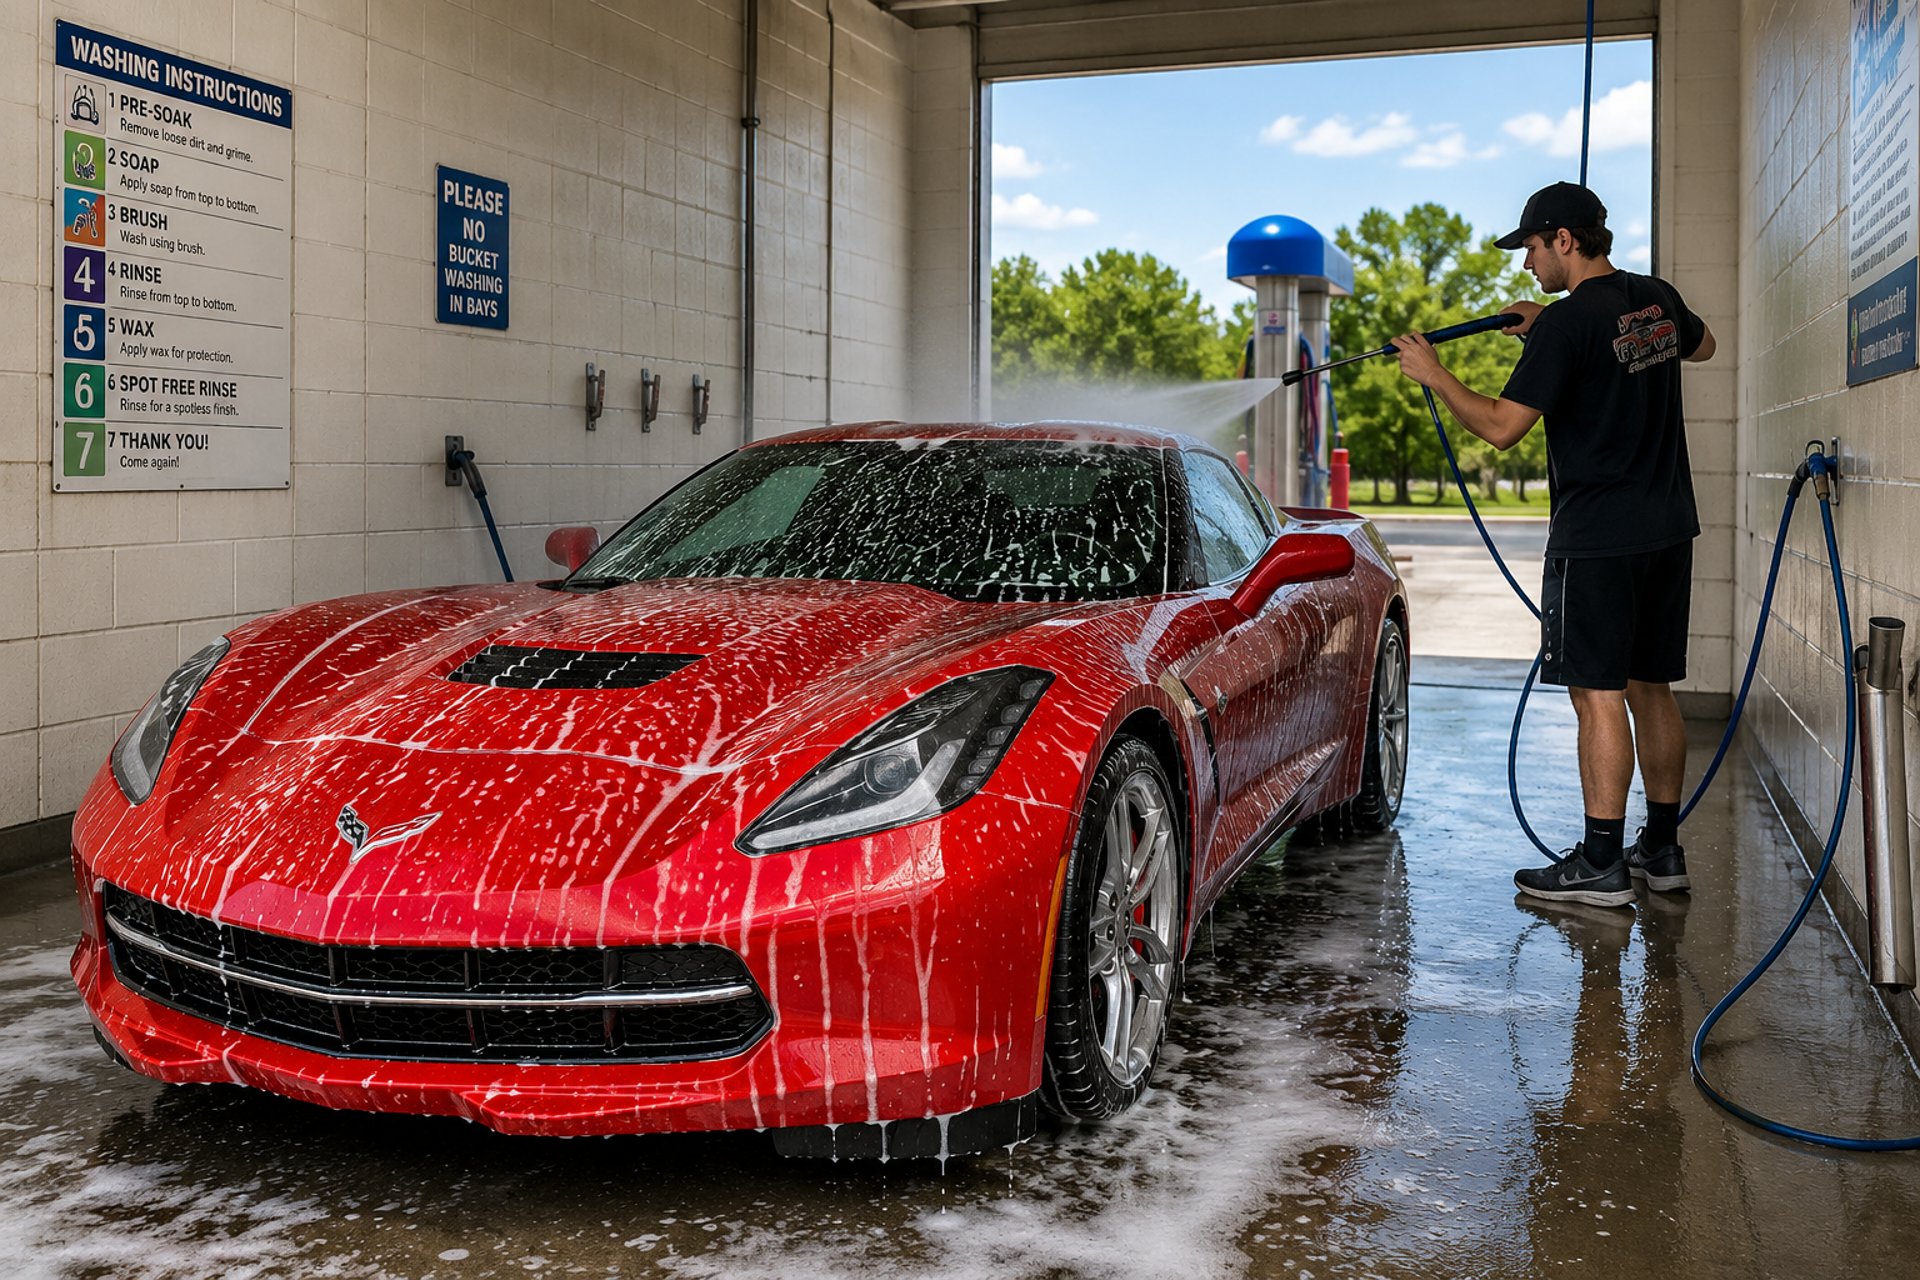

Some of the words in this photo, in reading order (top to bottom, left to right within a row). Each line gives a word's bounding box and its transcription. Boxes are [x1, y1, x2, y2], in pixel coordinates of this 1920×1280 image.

[71, 35, 159, 82] WASHING
[166, 64, 282, 118] INSTRUCTIONS
[108, 92, 115, 108] 1
[120, 94, 192, 129] PRE-SOAK
[120, 117, 159, 139] Remove
[162, 128, 187, 146] loose
[190, 136, 205, 151] dirt
[207, 143, 224, 155] and
[226, 148, 253, 163] grime.
[108, 147, 117, 165] 2
[120, 151, 159, 174] SOAP
[120, 174, 148, 192] Apply
[150, 183, 173, 198] soap
[175, 185, 196, 201] from
[198, 191, 214, 207] top
[215, 195, 225, 207] to
[444, 179, 503, 216] PLEASE
[108, 204, 116, 220] 3
[120, 207, 168, 231] BRUSH
[463, 217, 486, 243] NO
[120, 229, 147, 246] Wash
[150, 236, 175, 254] using
[177, 242, 206, 256] brush.
[449, 243, 499, 270] BUCKET
[74, 256, 95, 293] 4
[108, 261, 116, 276] 4
[120, 263, 161, 284] RINSE
[444, 268, 503, 294] WASHING
[120, 285, 147, 300] Rinse
[149, 289, 171, 303] from
[174, 293, 189, 308] top
[191, 296, 201, 307] to
[450, 294, 463, 313] IN
[467, 297, 498, 318] BAYS
[73, 314, 96, 351] 5
[108, 317, 116, 333] 5
[120, 318, 155, 338] WAX
[120, 342, 148, 358] Apply
[150, 347, 170, 357] wax
[171, 345, 185, 359] for
[186, 350, 234, 364] protection.
[74, 372, 94, 409] 6
[107, 373, 116, 390] 6
[120, 374, 158, 393] SPOT
[162, 378, 195, 395] FREE
[199, 380, 237, 398] RINSE
[120, 398, 147, 411] Rinse
[150, 399, 163, 412] for
[165, 404, 171, 413] a
[173, 402, 211, 416] spotless
[76, 431, 95, 470] 7
[107, 431, 116, 448] 7
[120, 431, 171, 450] THANK
[175, 434, 209, 450] YOU!
[120, 455, 148, 468] Come
[151, 456, 180, 471] again!
